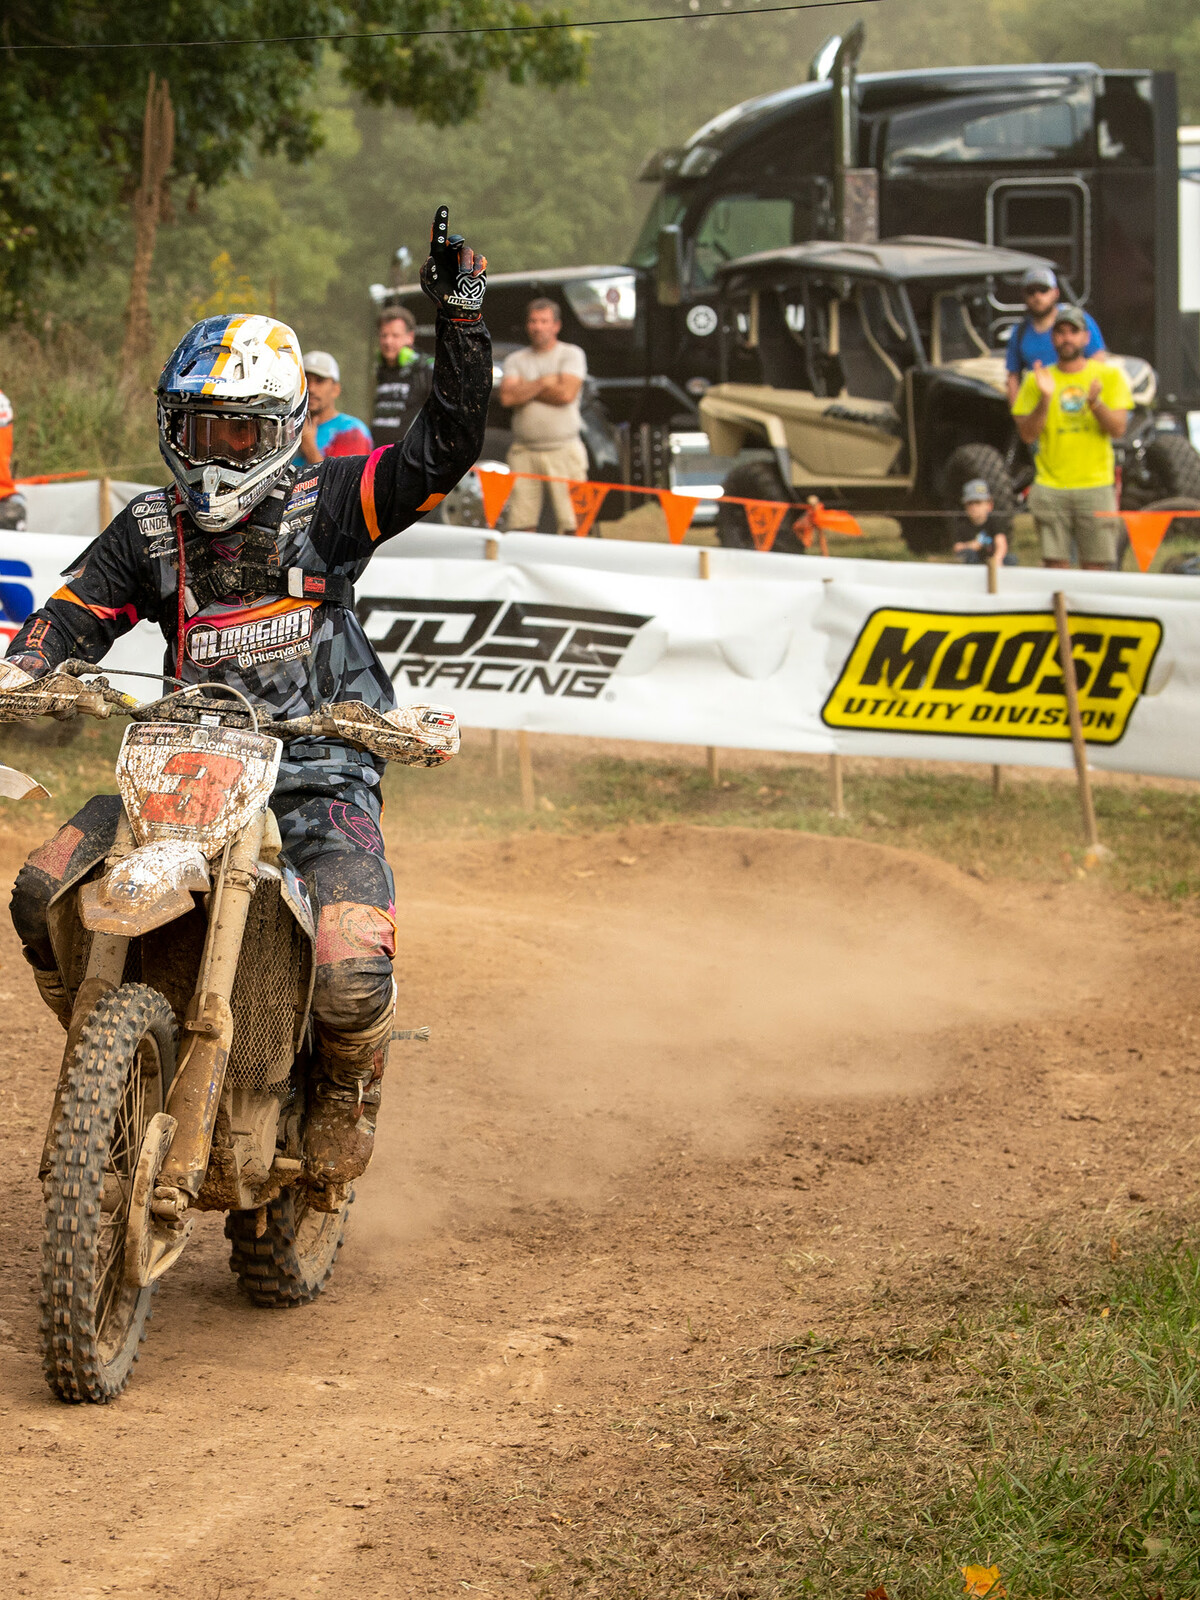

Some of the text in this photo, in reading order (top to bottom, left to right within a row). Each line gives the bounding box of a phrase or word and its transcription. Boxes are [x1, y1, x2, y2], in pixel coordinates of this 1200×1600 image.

[138, 516, 171, 533] VANDE
[220, 633, 299, 657] MOTORSPORTS
[355, 596, 655, 668] OOSE
[253, 640, 311, 664] Husqvarna
[858, 626, 1141, 699] MOOSE
[390, 658, 612, 699] RACING
[843, 697, 963, 720] UTILITY
[140, 752, 245, 827] 3
